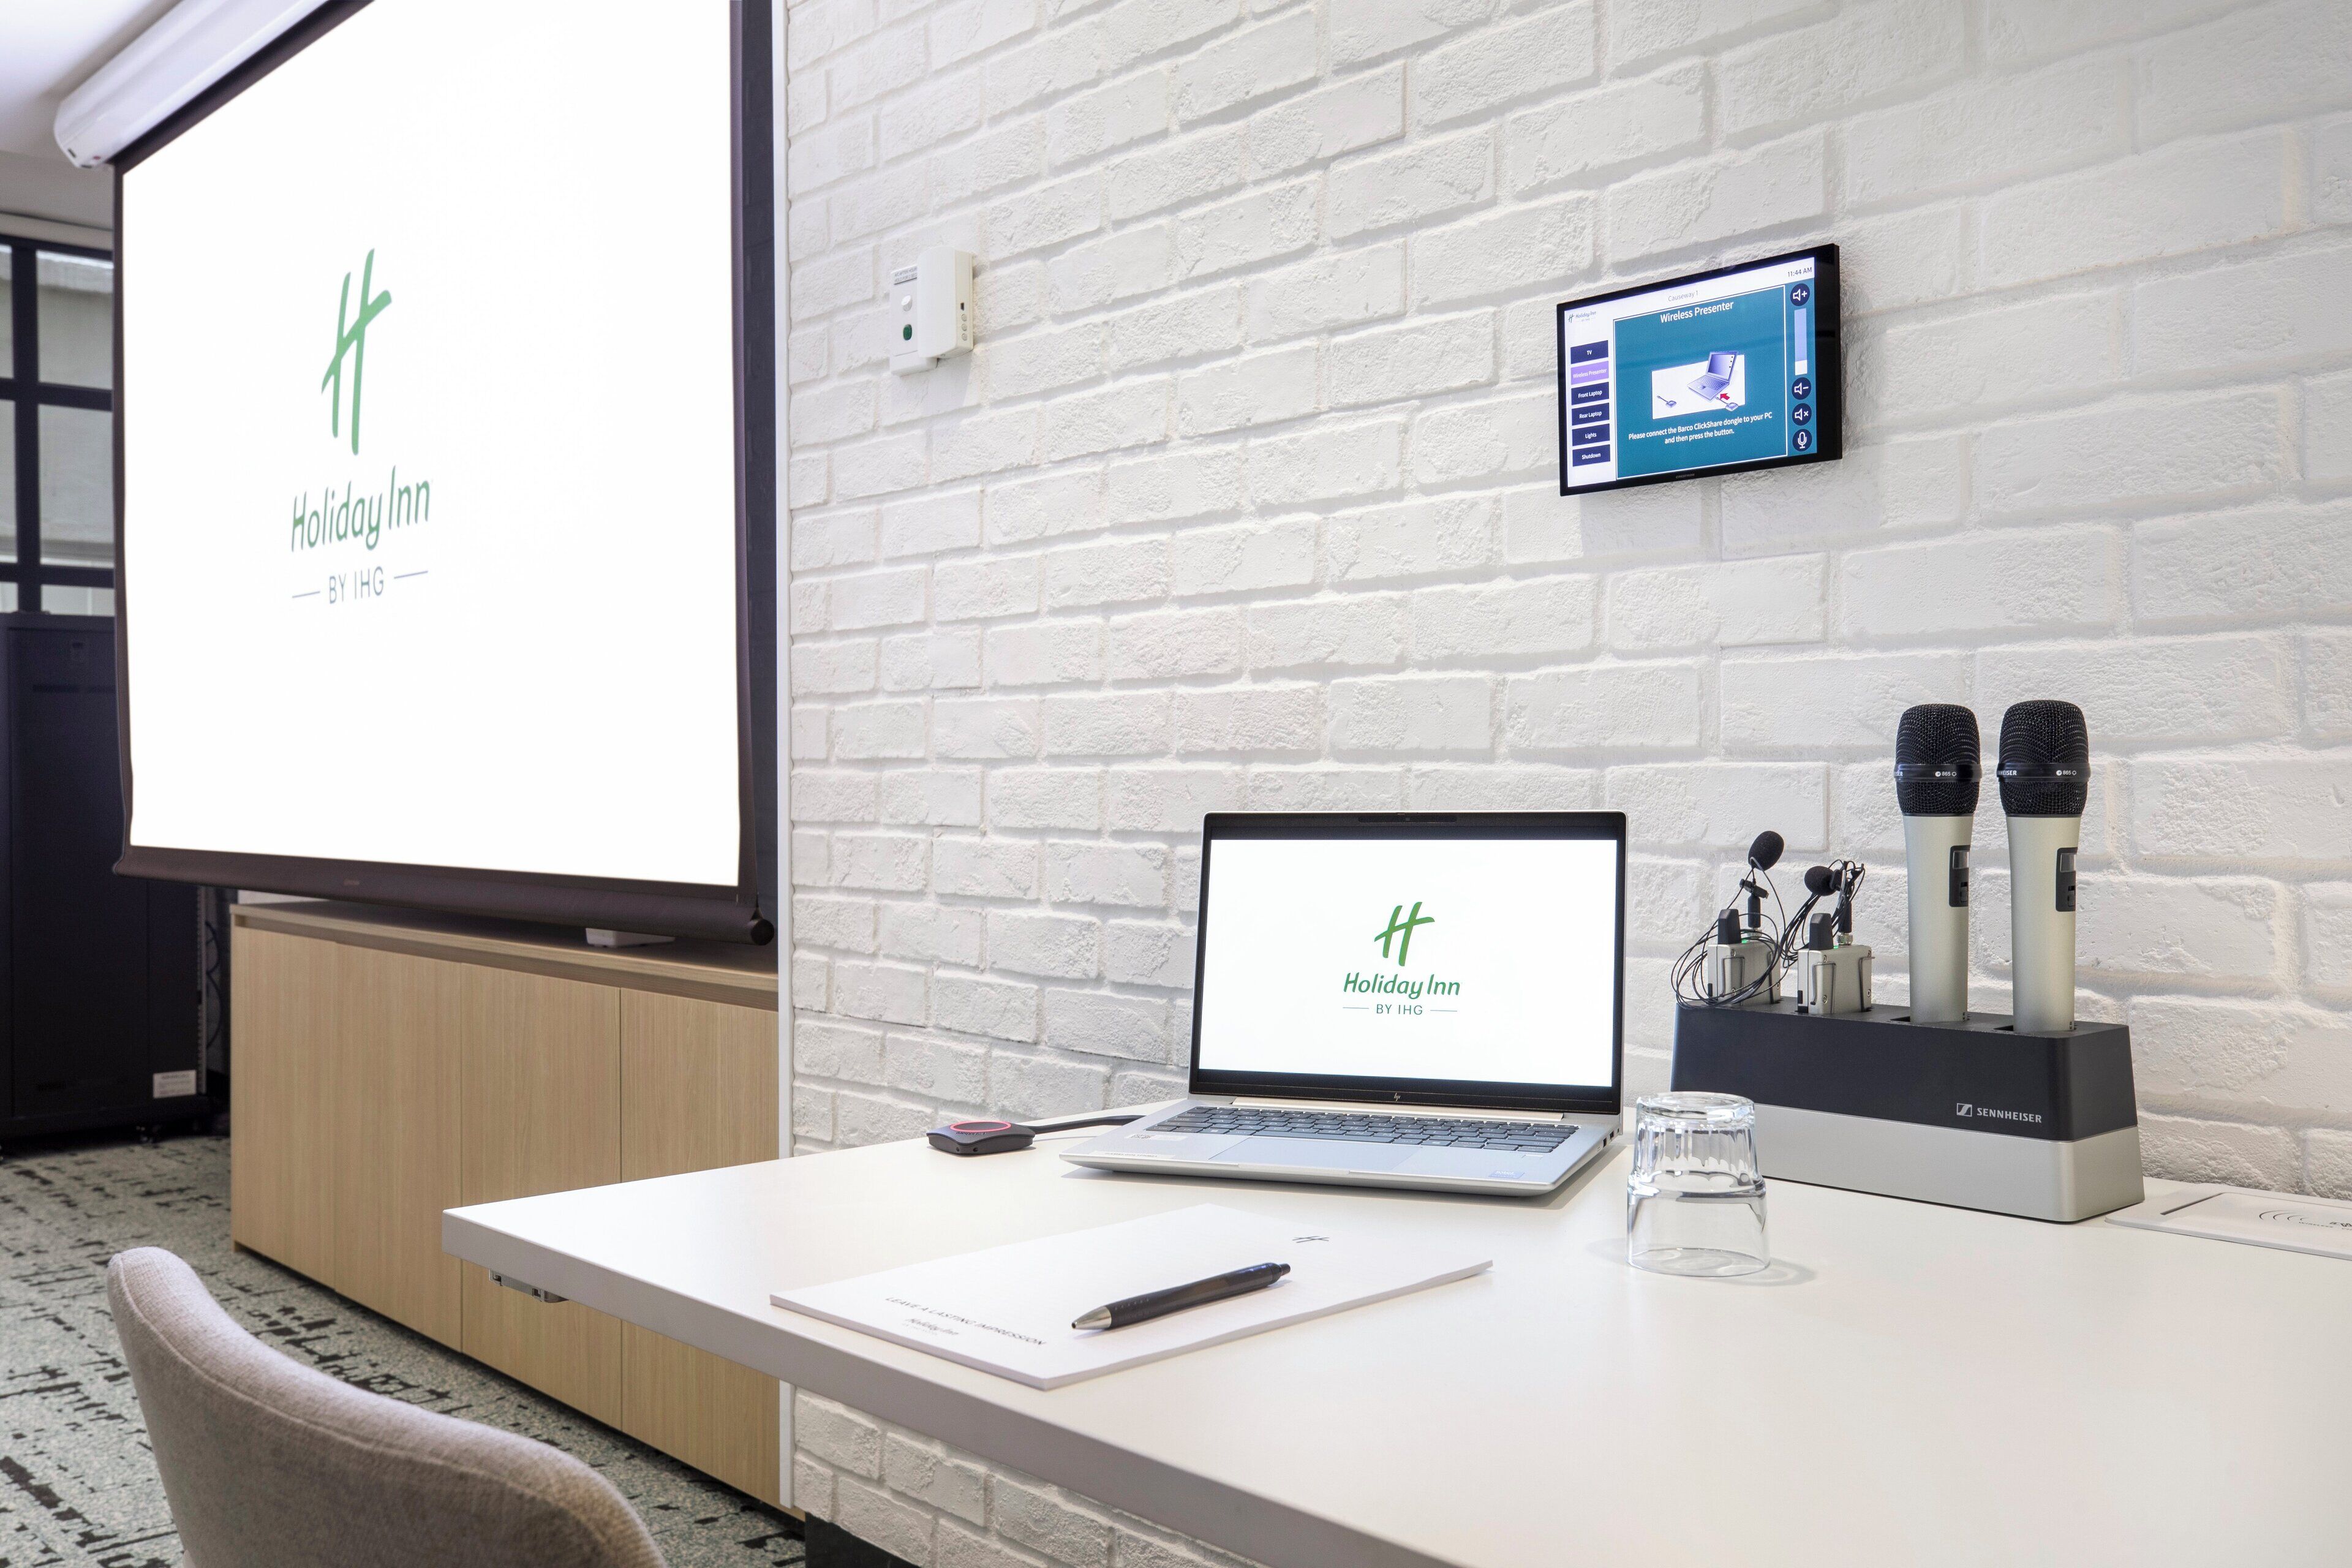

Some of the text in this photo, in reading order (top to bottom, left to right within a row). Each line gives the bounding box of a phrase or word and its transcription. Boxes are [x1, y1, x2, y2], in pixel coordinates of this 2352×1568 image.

[1668, 290, 1695, 302] Causeway
[1660, 301, 1734, 323] Wireless Presenter
[1694, 420, 1722, 430] ClickShare
[1723, 417, 1743, 428] dongle
[1750, 414, 1763, 423] your
[1689, 433, 1703, 442] press
[1714, 428, 1735, 437] button.
[292, 465, 430, 552] Holiday Inn
[330, 566, 384, 604] BY IHG
[1343, 972, 1461, 1000] Holiday Inn
[1376, 1004, 1423, 1016] BY IHG
[1977, 1107, 2042, 1123] SENNHEISER
[885, 1297, 921, 1308] LEAVE
[929, 1310, 977, 1325] LASTING
[974, 1322, 1047, 1346] IMPRESSION
